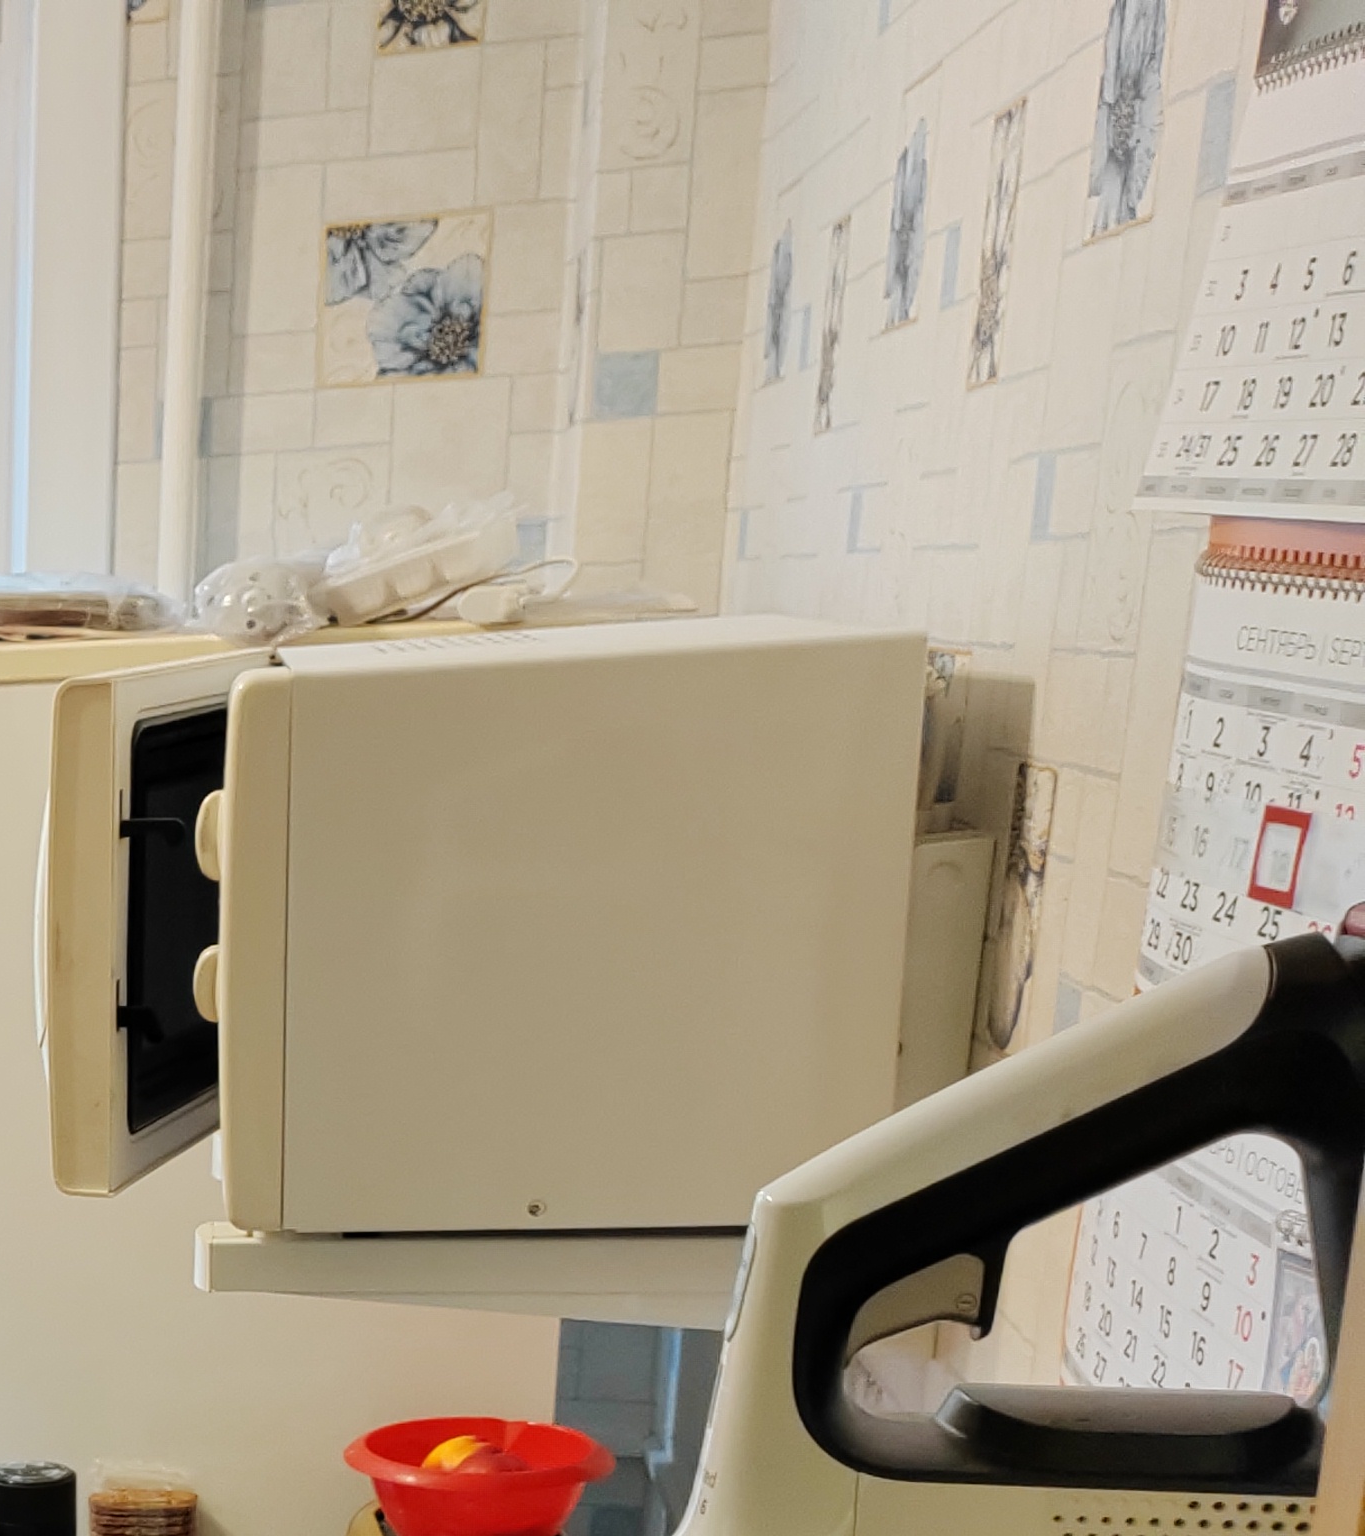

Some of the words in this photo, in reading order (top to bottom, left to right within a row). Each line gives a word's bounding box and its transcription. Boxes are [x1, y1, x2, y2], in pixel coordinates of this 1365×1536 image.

[1234, 268, 1249, 301] 3
[1270, 263, 1282, 295] 4
[1303, 257, 1317, 291] 5
[1342, 250, 1357, 285] 6
[1216, 325, 1236, 356] 10
[1253, 321, 1270, 353] 11
[1289, 317, 1307, 350] 12
[1328, 312, 1348, 347] 13
[1200, 381, 1221, 412] 17
[1238, 378, 1257, 411] 18
[1273, 376, 1293, 409] 19
[1308, 373, 1335, 408] 20
[1350, 371, 1365, 406] 2
[1216, 435, 1243, 467] 25
[1254, 434, 1280, 467] 26
[1292, 434, 1319, 467] 27
[1330, 432, 1358, 467] 28
[1212, 716, 1225, 748] 2
[1257, 725, 1271, 758] 3
[1299, 734, 1315, 768] 4
[1349, 744, 1365, 779] 5
[1205, 771, 1216, 804] 9
[1180, 879, 1200, 913] 23
[1212, 891, 1239, 928] 24
[1256, 906, 1283, 941] 25
[1147, 918, 1162, 951] 29
[1172, 931, 1193, 966] 30
[1245, 1151, 1304, 1205] OCTOBE
[1175, 1205, 1182, 1235] 1
[1208, 1228, 1219, 1260] 2
[1245, 1253, 1260, 1286] 3
[1112, 1210, 1120, 1239] 6
[1138, 1232, 1148, 1260] 7
[1167, 1256, 1176, 1286] 8
[1200, 1281, 1211, 1312] 9
[1235, 1304, 1253, 1343] 10
[1097, 1302, 1112, 1337] 20
[1123, 1328, 1138, 1363] 21
[1150, 1354, 1167, 1389] 22
[1106, 1256, 1117, 1288] 13
[1130, 1279, 1144, 1314] 14
[1159, 1304, 1172, 1339] 15
[1191, 1330, 1207, 1367] 16
[1227, 1358, 1244, 1389] 17
[1093, 1350, 1107, 1383] 27
